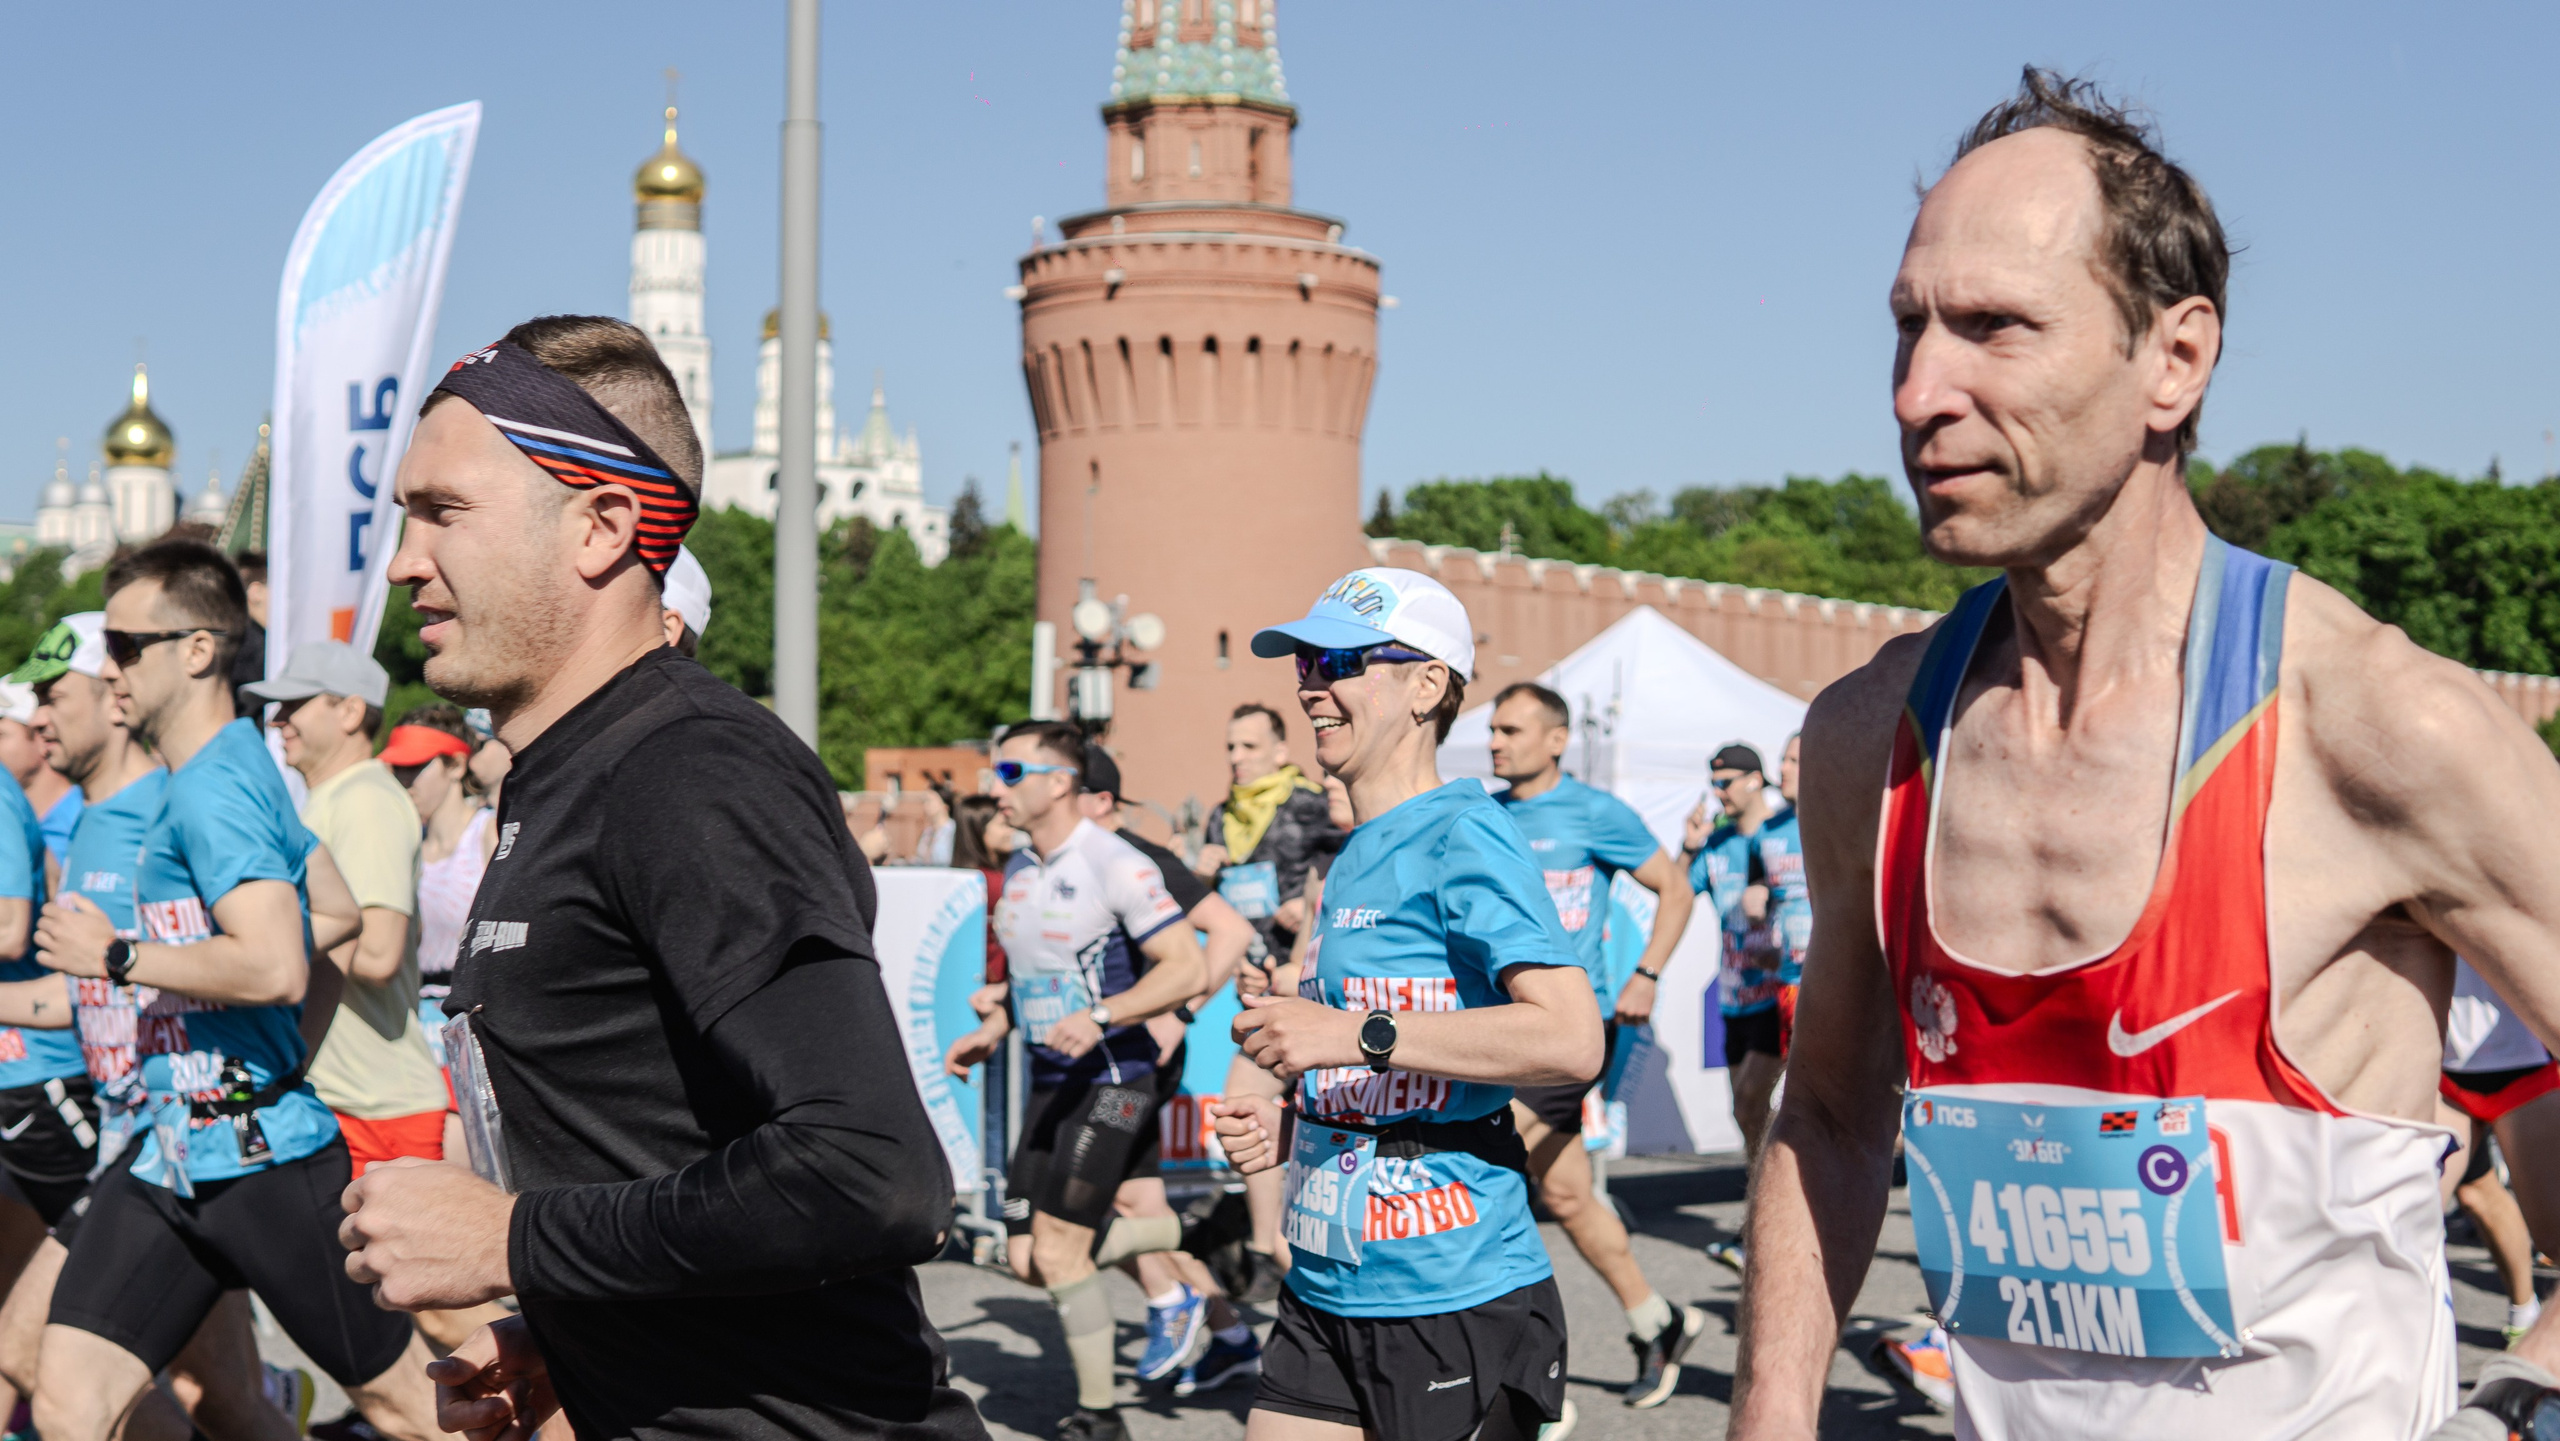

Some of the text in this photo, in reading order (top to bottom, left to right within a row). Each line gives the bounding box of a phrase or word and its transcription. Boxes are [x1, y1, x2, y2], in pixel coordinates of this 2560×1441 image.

[1936, 1105, 1978, 1129] ПСБ
[1368, 1156, 1433, 1196] 024
[1968, 1179, 2152, 1277] 41655
[1998, 1275, 2147, 1358] 21.1KM
